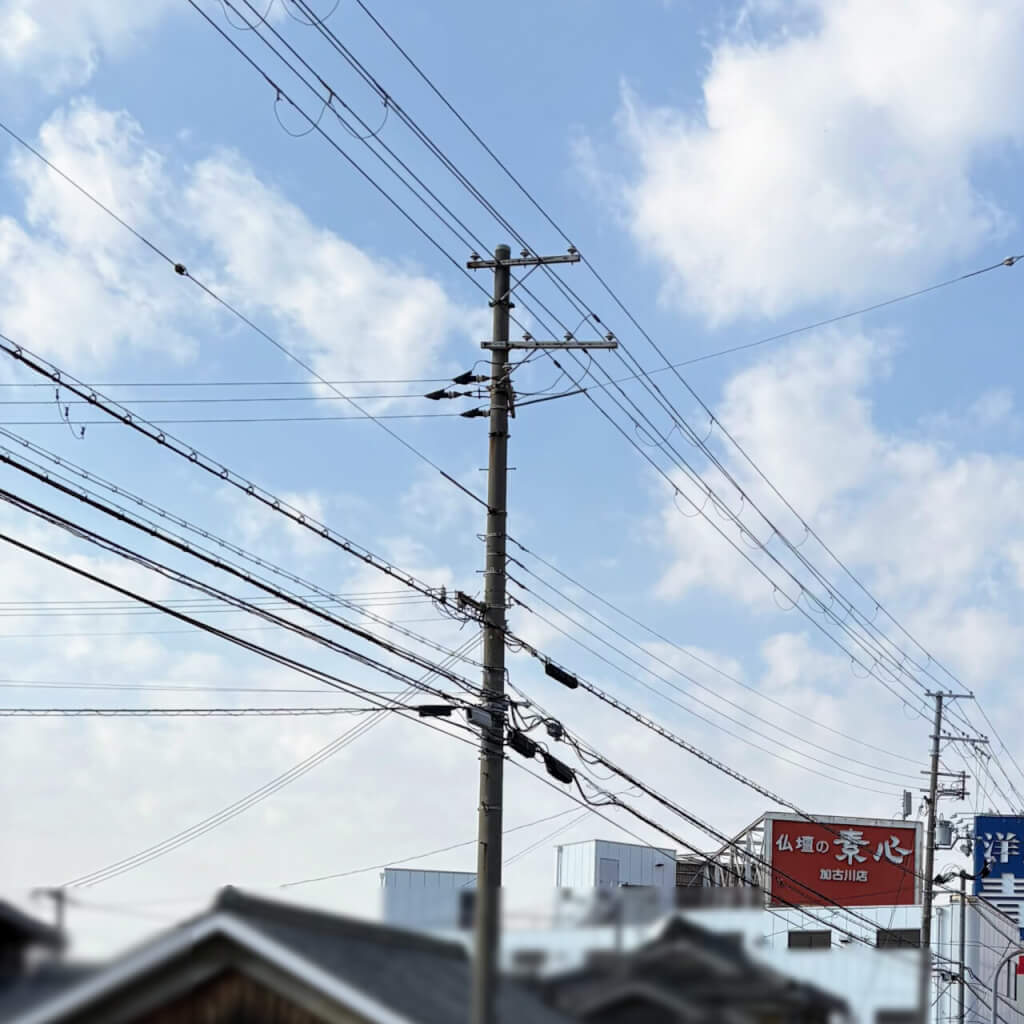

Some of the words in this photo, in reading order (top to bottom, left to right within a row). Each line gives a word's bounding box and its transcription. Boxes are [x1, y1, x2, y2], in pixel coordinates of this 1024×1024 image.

[776, 828, 912, 865] 仏壇の素心
[820, 869, 868, 882] 加古川店
